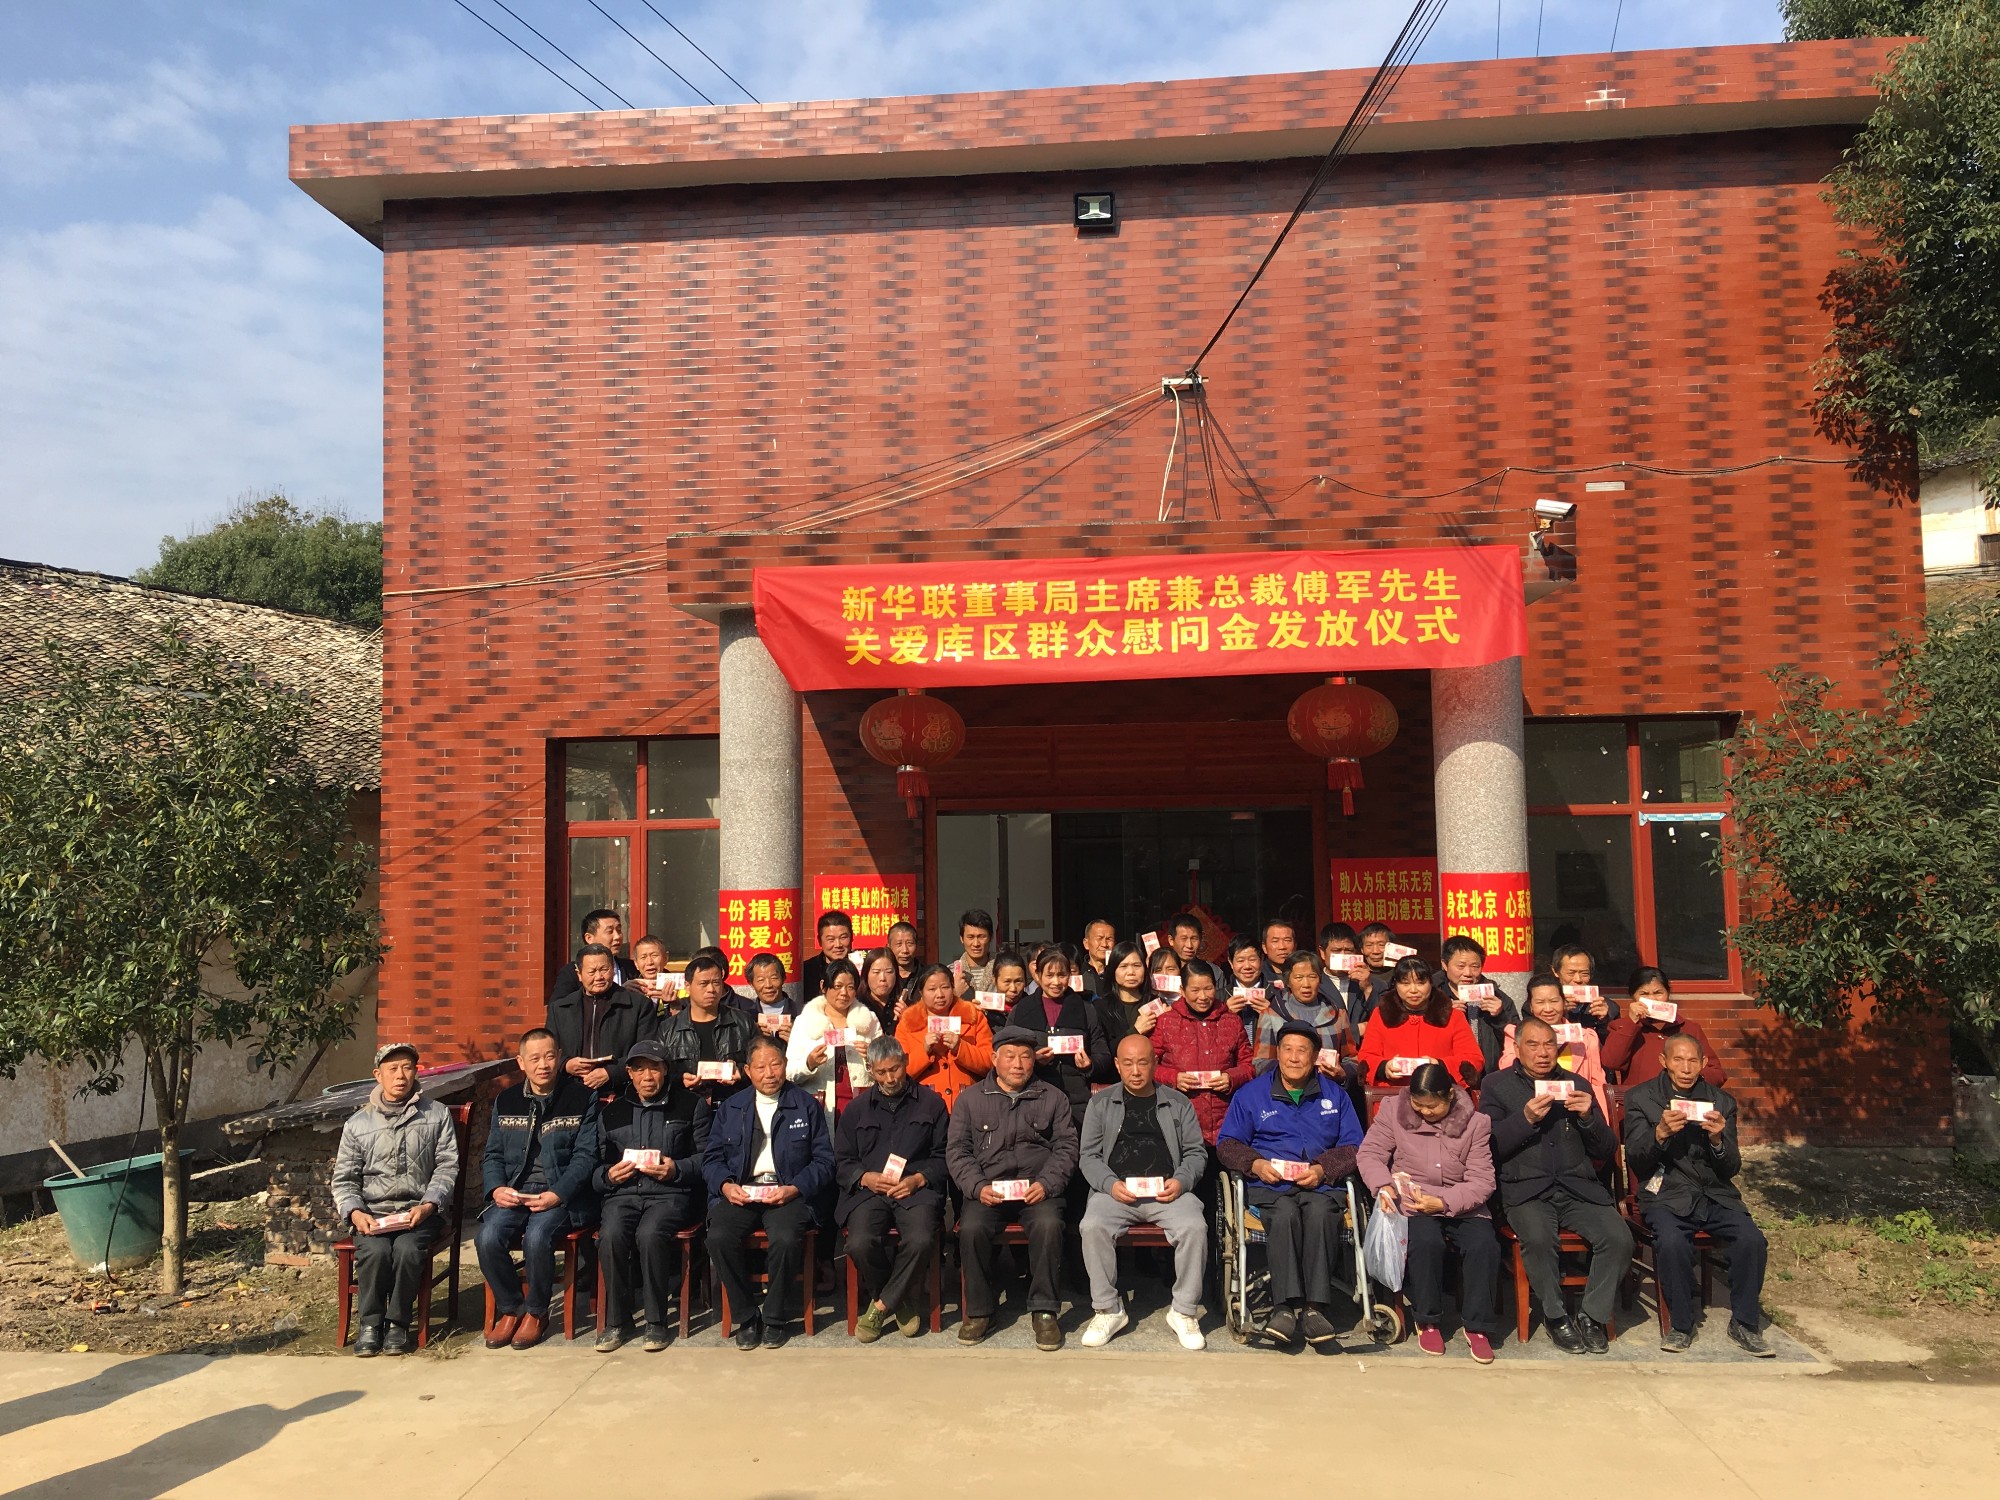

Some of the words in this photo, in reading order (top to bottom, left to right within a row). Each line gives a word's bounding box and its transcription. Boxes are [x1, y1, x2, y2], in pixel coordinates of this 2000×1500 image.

[842, 567, 1461, 622] 新华联董事局主席兼总裁傅军先生
[845, 605, 1461, 666] 关爱库区群众慰问金发放仪式
[1340, 870, 1433, 894] 助人为乐其乐无穷
[821, 886, 910, 910] 做慈善事业的行动者
[1341, 898, 1435, 921] 扶贫助困功德无量
[1446, 889, 1498, 919] 身在北京
